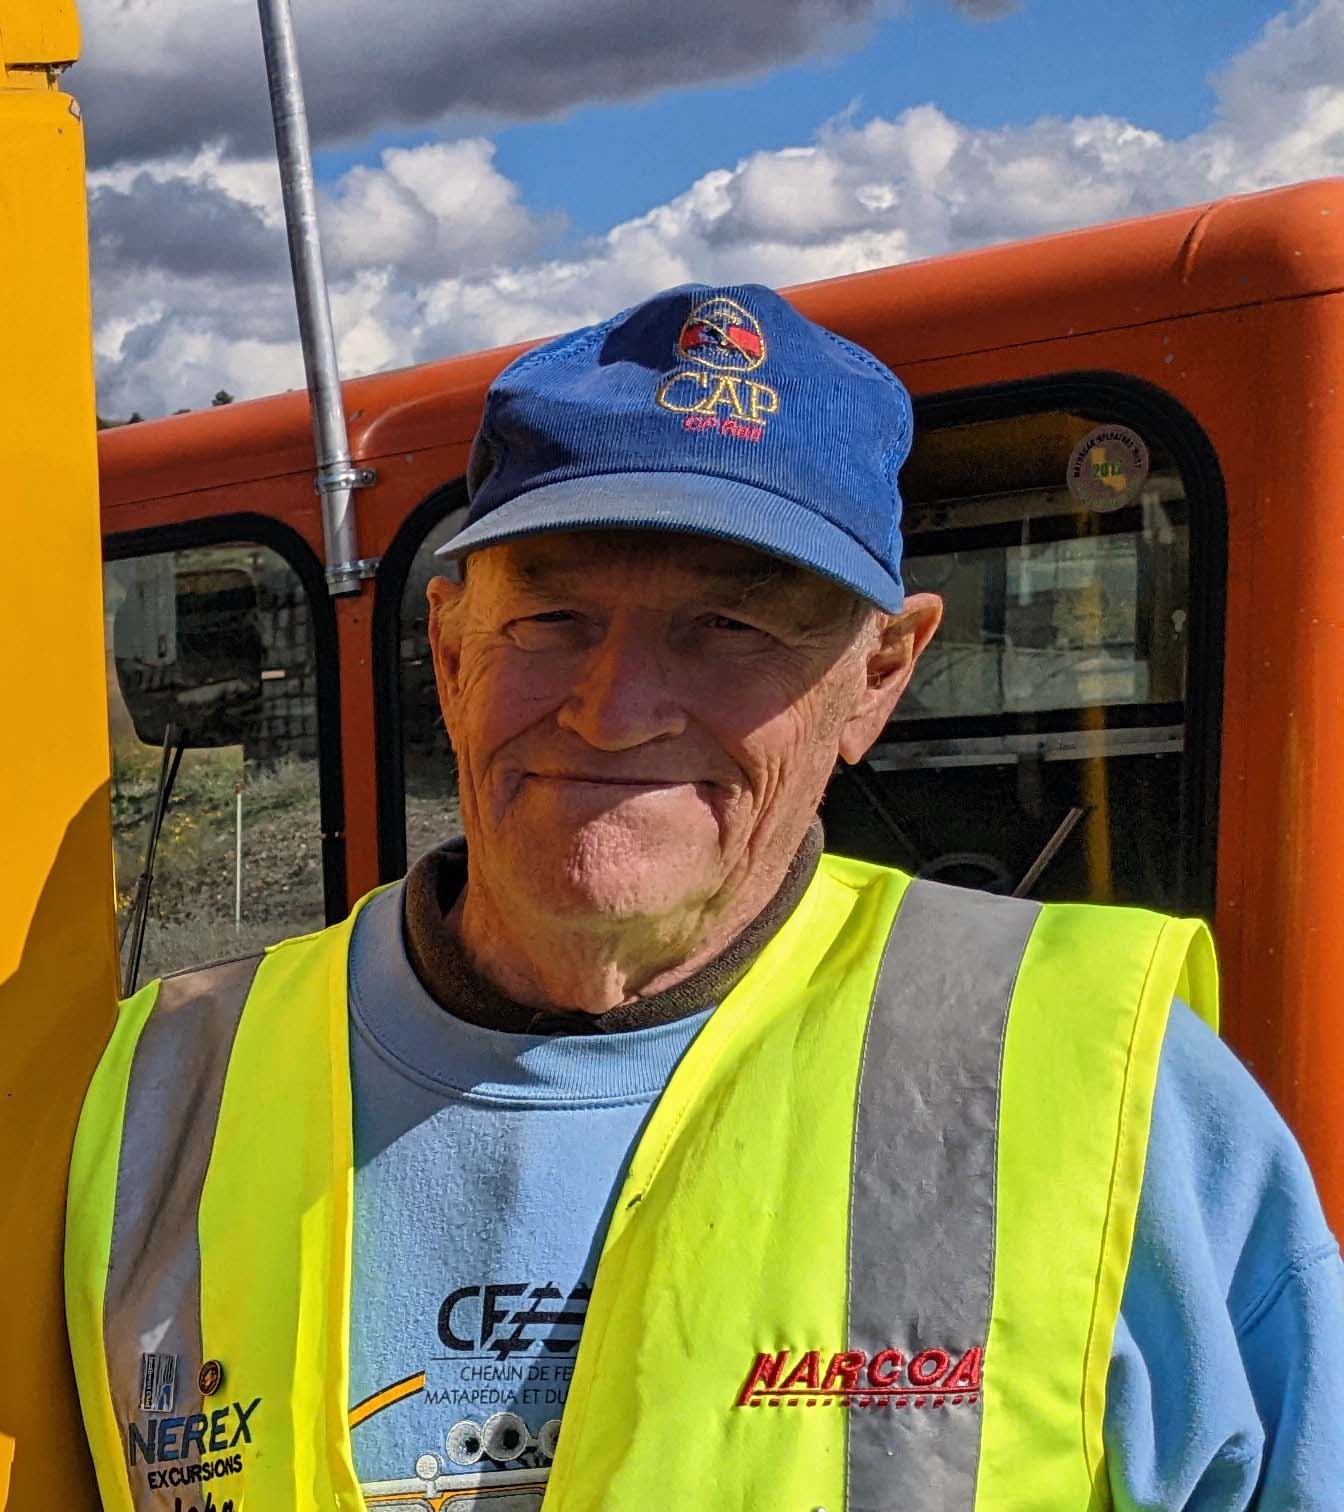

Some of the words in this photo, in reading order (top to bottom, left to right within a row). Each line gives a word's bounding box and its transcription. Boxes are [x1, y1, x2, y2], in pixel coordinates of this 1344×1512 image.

[656, 371, 780, 424] CAP
[461, 1366, 524, 1382] CHEMIN
[528, 1365, 550, 1381] DE
[736, 1346, 984, 1407] NARCOA
[522, 1389, 543, 1405] ET
[127, 1397, 263, 1467] NEREX
[147, 1453, 244, 1490] EXCURSIONS
